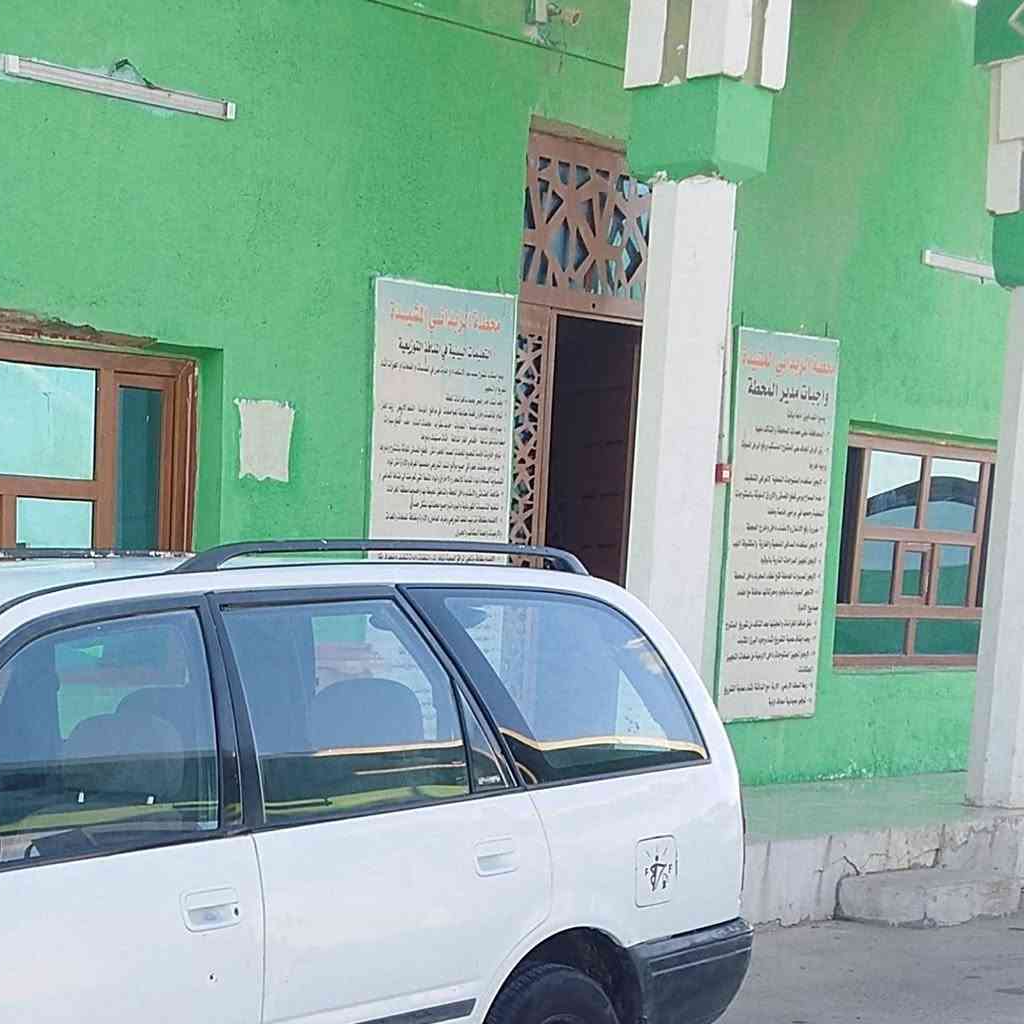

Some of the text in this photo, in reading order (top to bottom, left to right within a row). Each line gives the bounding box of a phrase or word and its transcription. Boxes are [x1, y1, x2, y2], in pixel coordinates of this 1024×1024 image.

[747, 376, 829, 407] واجبات مدير المحطة
